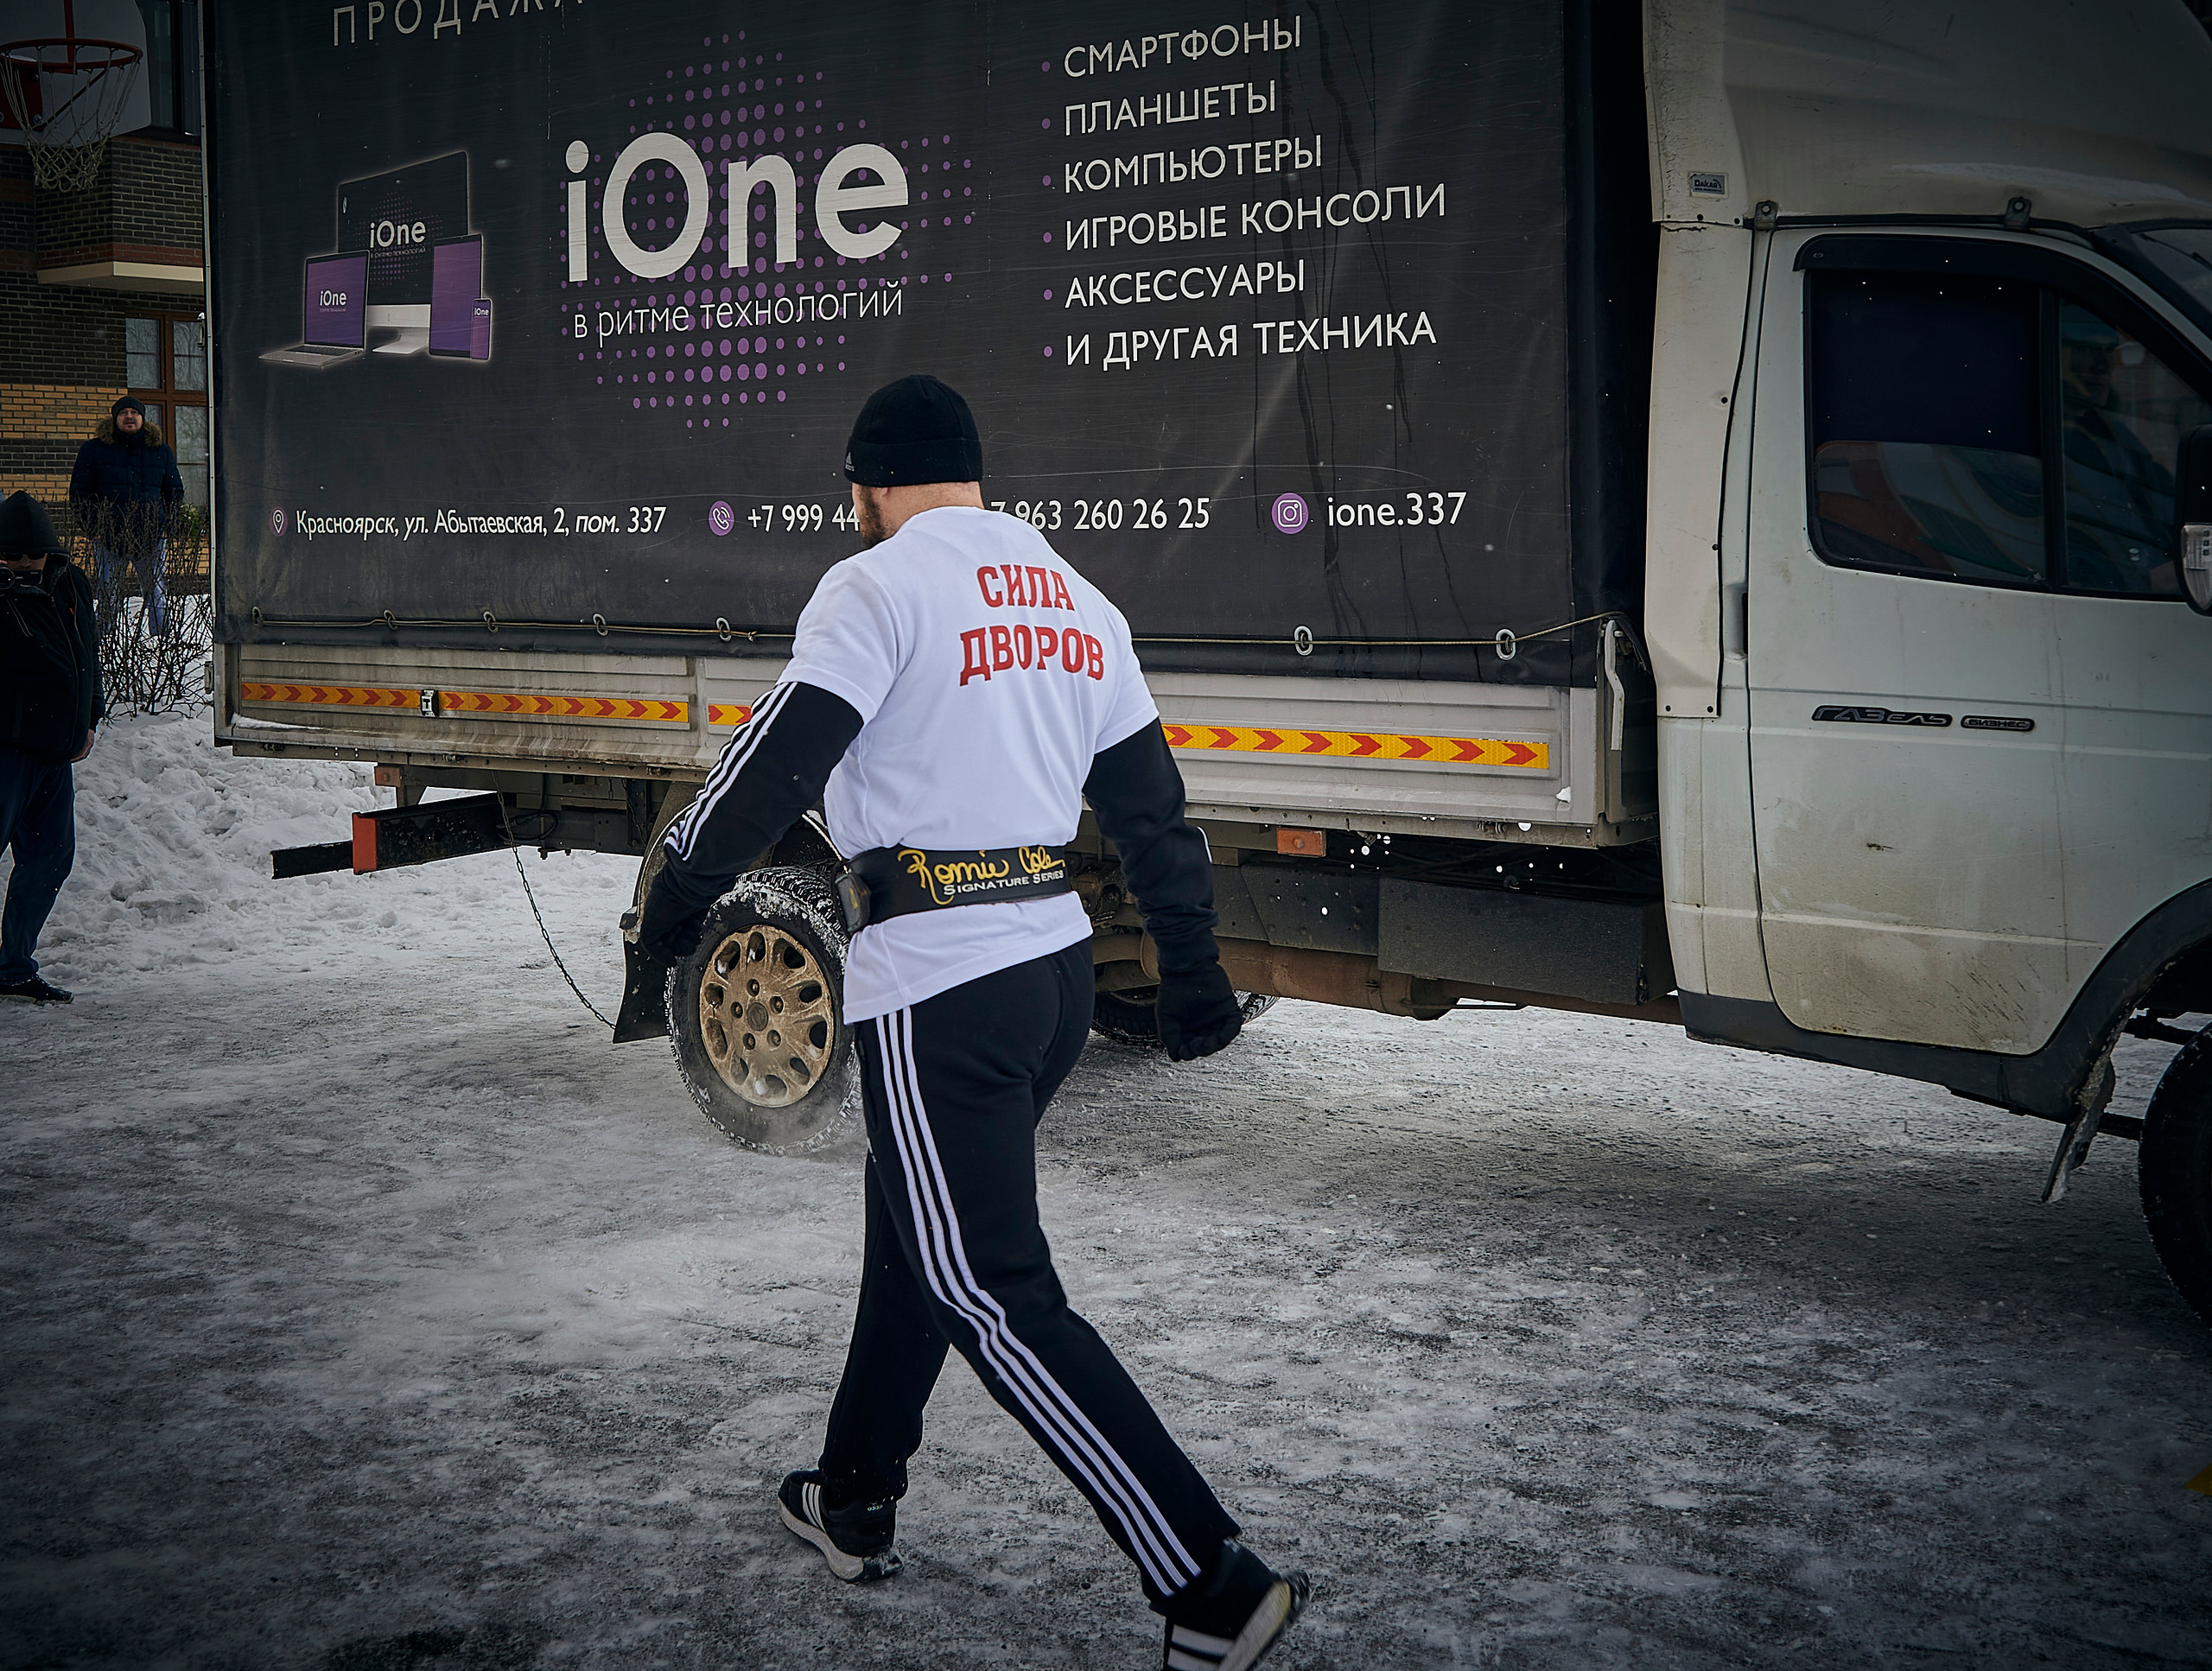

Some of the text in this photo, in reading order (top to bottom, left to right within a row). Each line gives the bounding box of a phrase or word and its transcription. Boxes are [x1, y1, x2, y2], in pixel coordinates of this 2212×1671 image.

[334, 0, 582, 45] ПРОДА
[1065, 16, 1300, 76] СМАРТФОНЫ
[1066, 80, 1274, 135] ПЛАНШЕТЫ
[1066, 135, 1320, 193] КОМПЬЮТЕРЫ
[566, 133, 908, 282] iOne
[1067, 183, 1444, 250] ИГРОВЫЕ КОНСОЛИ
[370, 220, 426, 248] iOne
[320, 289, 347, 307] iOne
[1065, 259, 1303, 308] АКСЕССУАРЫ
[575, 282, 901, 347] в ритме технологий
[1068, 312, 1436, 371] И ДРУГАЯ ТЕХНИКА
[297, 507, 666, 540] Красноярск, ул. Абытаевская, 2, пом. 337
[748, 505, 773, 531] +7
[783, 505, 823, 531] 999
[1015, 499, 1061, 531] 963
[1074, 499, 1122, 529] 260
[1133, 499, 1166, 528] 26
[1179, 498, 1209, 528] 25
[1328, 492, 1466, 525] ione.337
[978, 565, 1073, 609] СИЛА
[961, 625, 1103, 684] ДВОРОВ
[944, 877, 1030, 896] SIGNATURE
